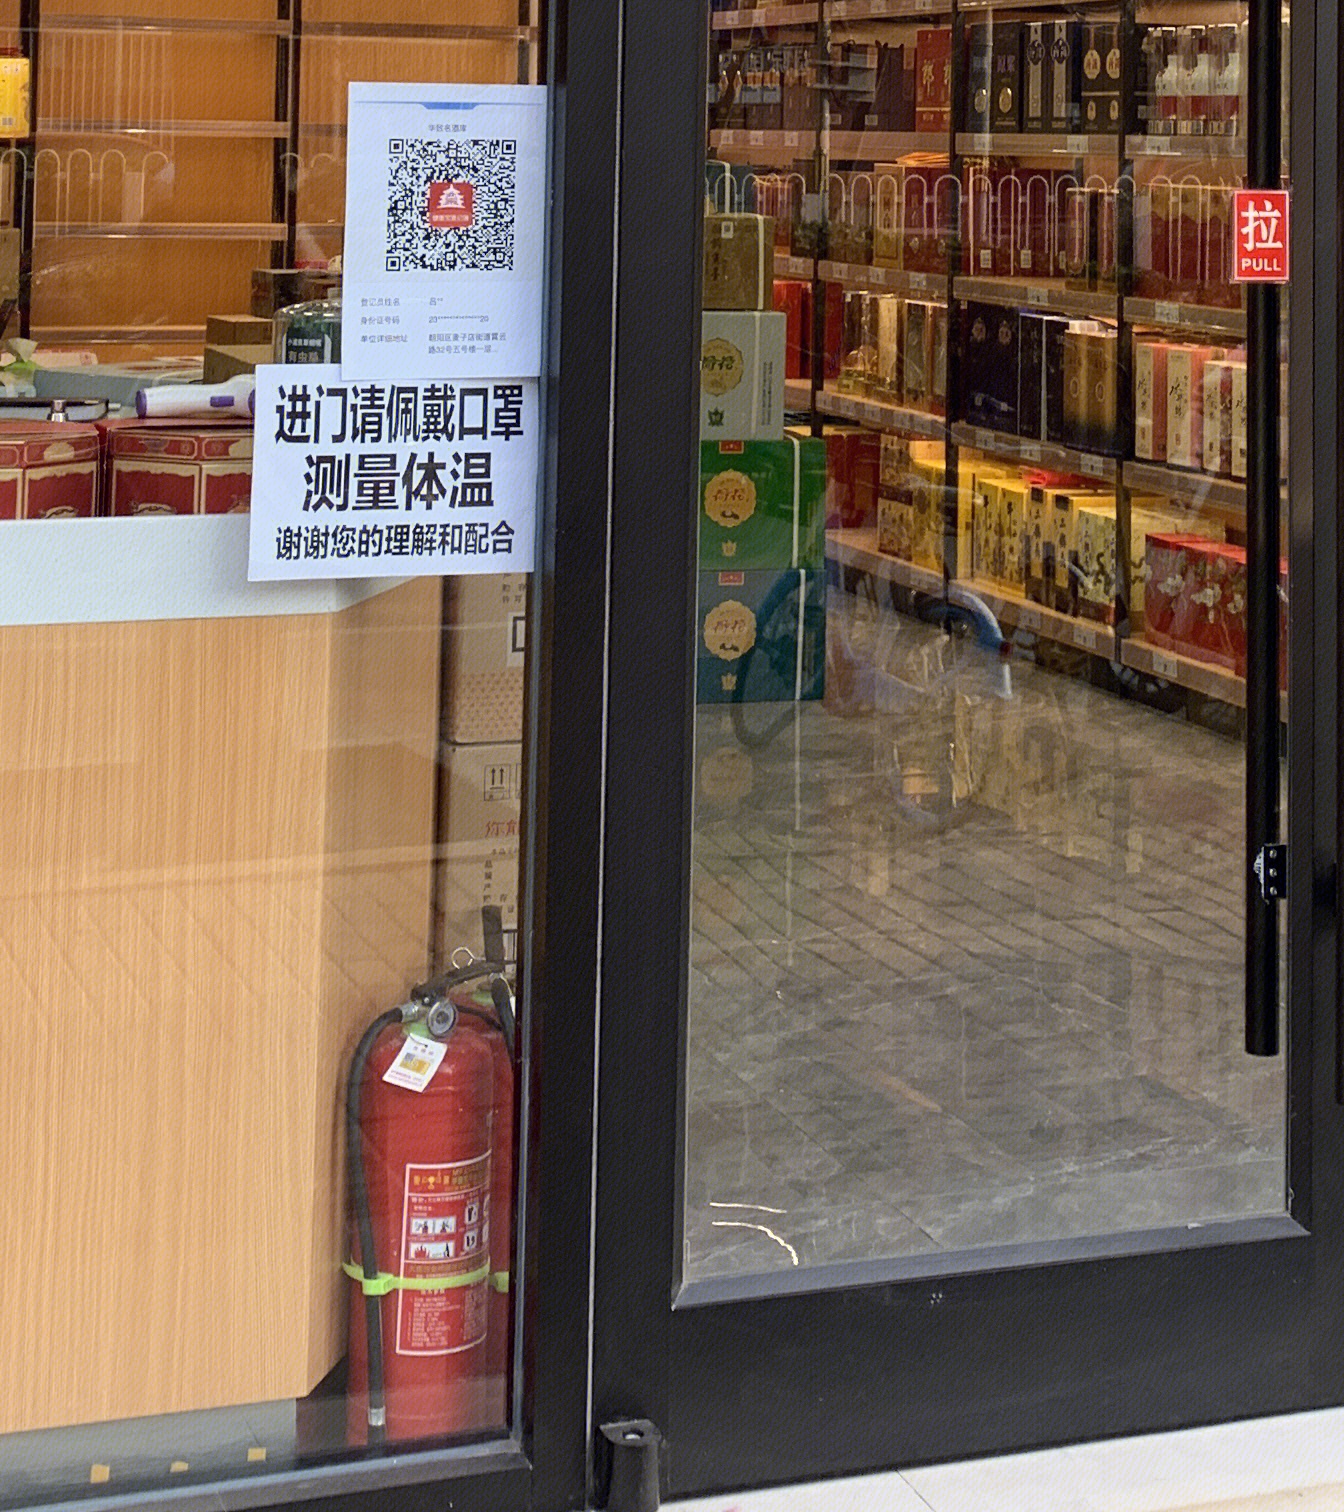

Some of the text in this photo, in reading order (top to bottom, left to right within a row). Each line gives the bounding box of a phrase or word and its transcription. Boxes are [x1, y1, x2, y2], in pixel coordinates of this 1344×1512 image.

[1241, 199, 1283, 252] 拉
[1241, 258, 1282, 273] PULL
[274, 384, 524, 445] 进门请佩戴口罩
[302, 452, 495, 513] 测量体温
[275, 520, 516, 561] 谢谢您的理解和配合
